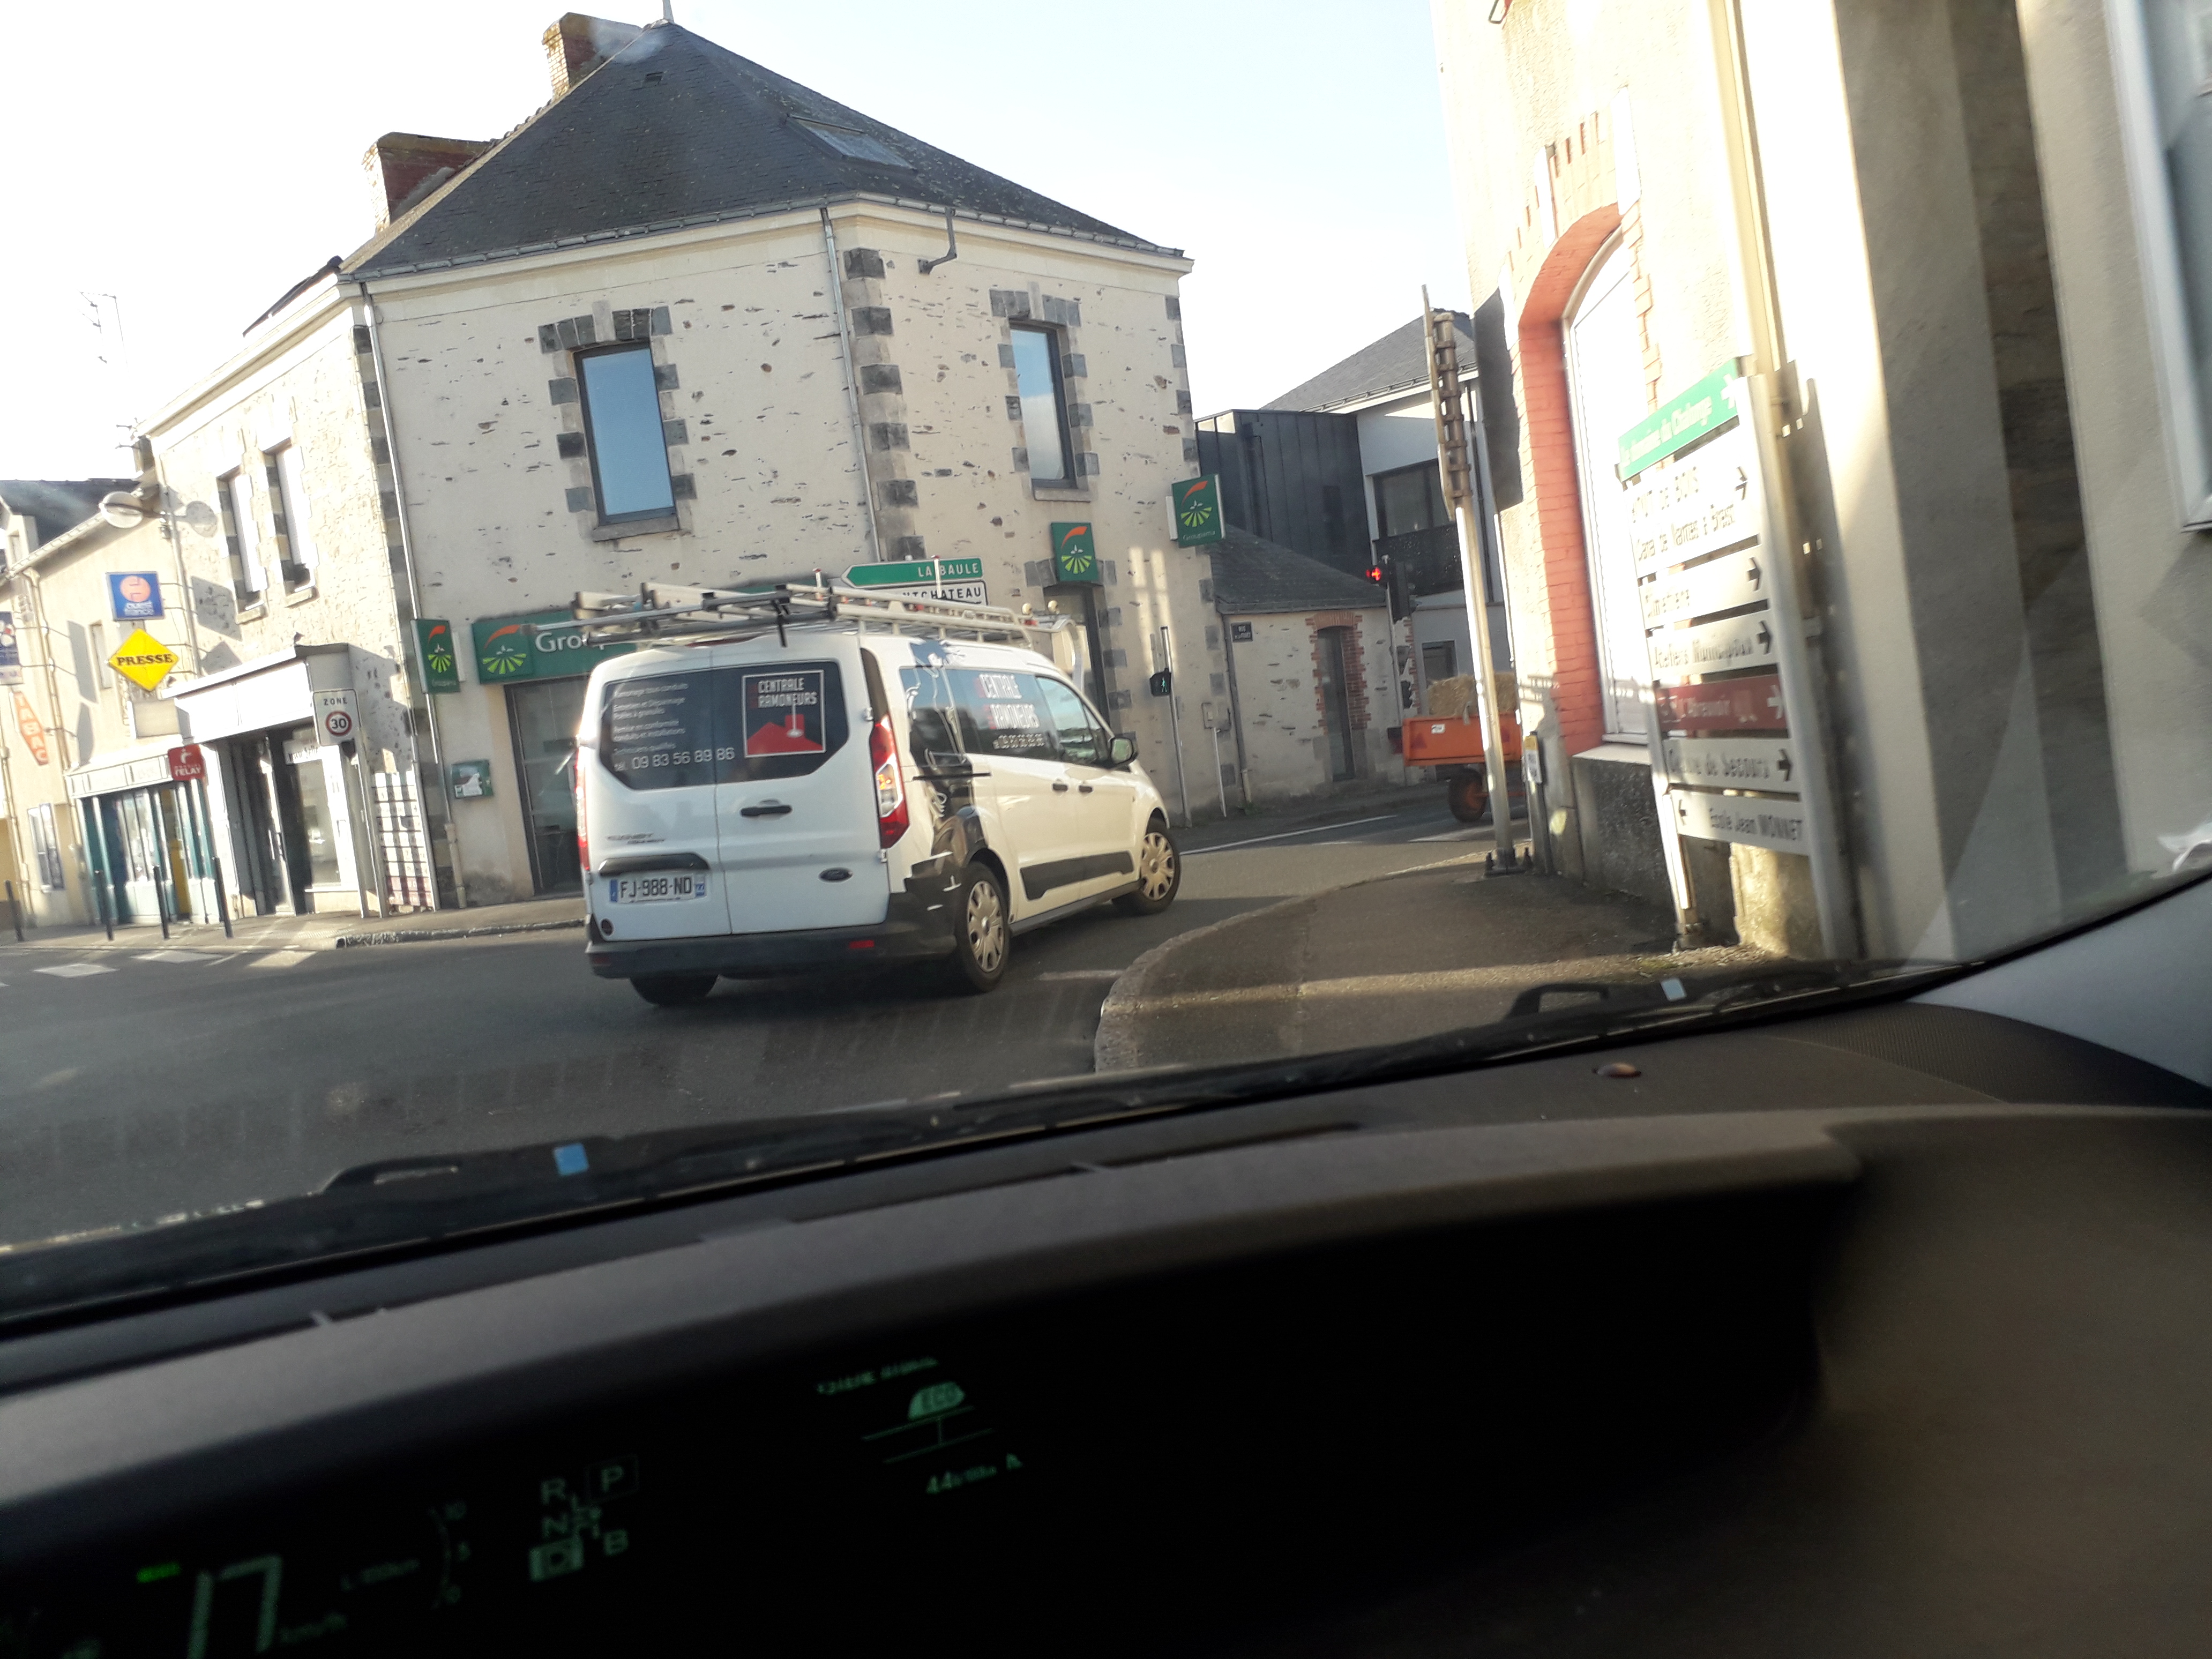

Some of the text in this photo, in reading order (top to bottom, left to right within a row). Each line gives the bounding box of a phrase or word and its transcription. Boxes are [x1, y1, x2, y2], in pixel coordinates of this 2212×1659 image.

[918, 563, 979, 577] LA BAULE
[116, 654, 174, 666] PRESSE
[758, 677, 805, 694] CENTRALE
[324, 697, 348, 706] ZONE
[758, 691, 818, 709] RAMONEURS
[331, 718, 347, 729] 30
[632, 756, 649, 769] 09
[672, 751, 691, 765] 56
[541, 1466, 624, 1505] R P
[603, 1529, 629, 1557] B
